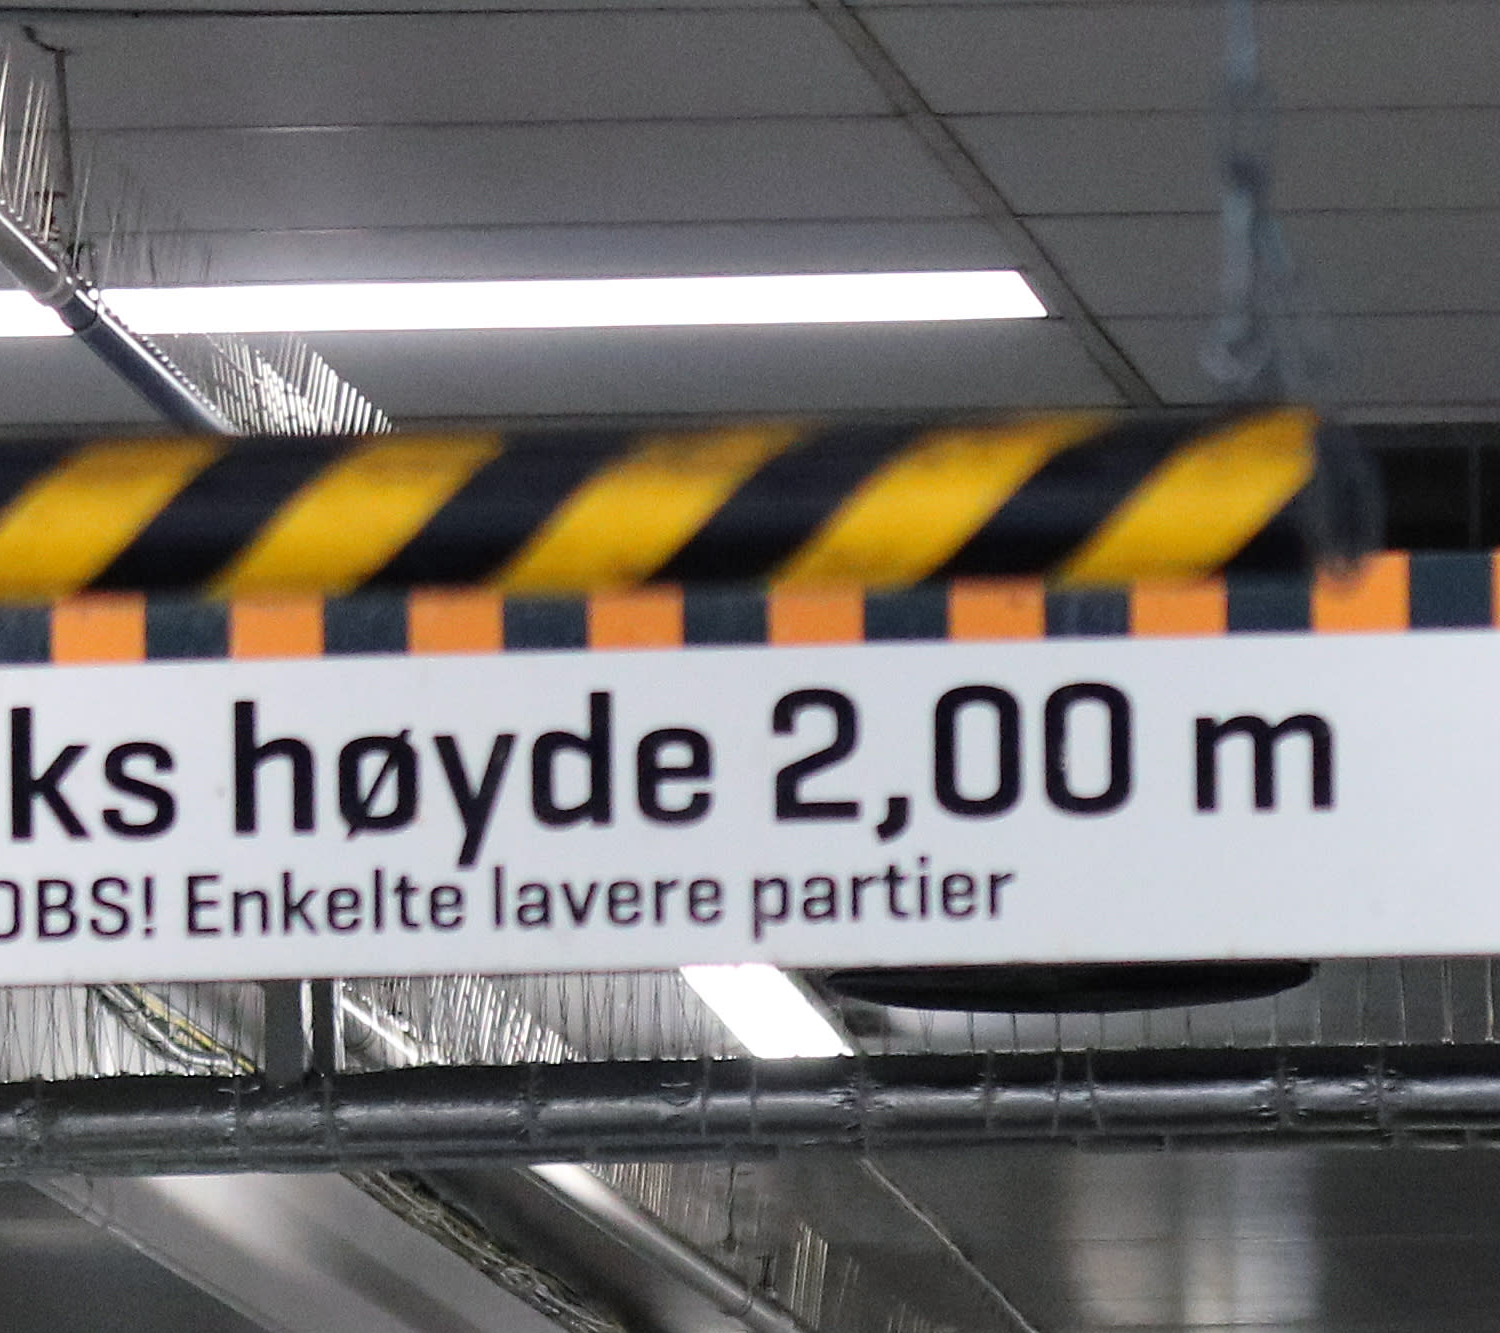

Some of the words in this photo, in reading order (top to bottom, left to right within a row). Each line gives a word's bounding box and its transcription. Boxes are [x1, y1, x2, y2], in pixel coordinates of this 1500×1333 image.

[233, 690, 714, 867] høyde
[772, 682, 1134, 842] 2,00
[1193, 709, 1334, 813] m
[186, 869, 464, 938] Enkelte
[494, 865, 724, 930] lavere
[753, 856, 1018, 941] partier
